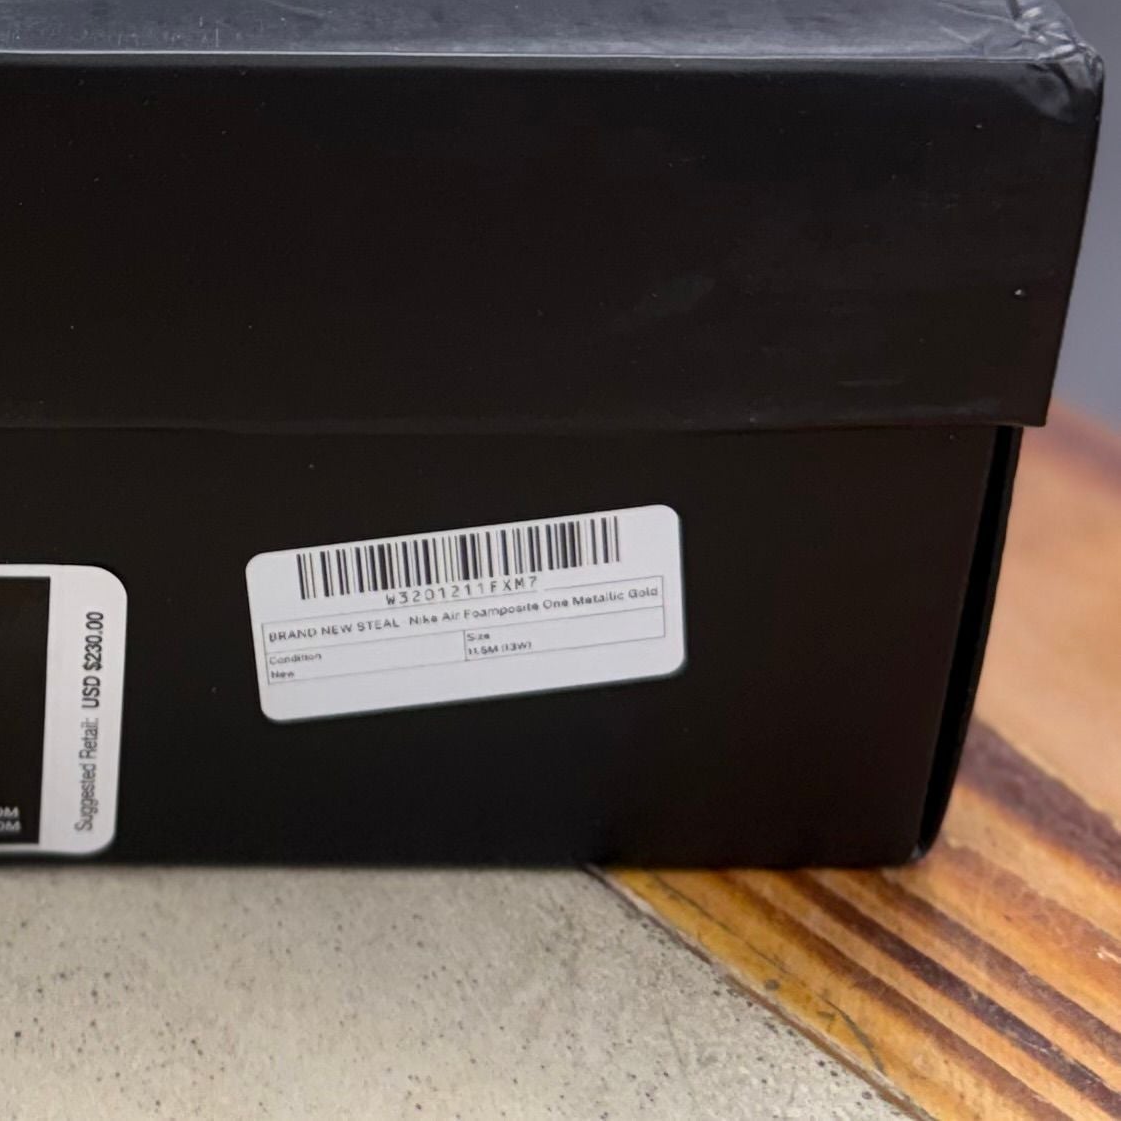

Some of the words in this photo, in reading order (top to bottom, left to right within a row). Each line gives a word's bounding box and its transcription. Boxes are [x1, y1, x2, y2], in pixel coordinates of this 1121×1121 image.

[385, 576, 538, 605] W3201211FXM7
[269, 629, 317, 643] BRAND
[321, 624, 353, 636] NEW
[357, 620, 400, 633] STEAL
[409, 614, 438, 626] Nike
[442, 611, 460, 622] Air
[464, 602, 539, 619] Foamposite
[542, 598, 569, 610] One
[572, 590, 625, 605] Metallic
[628, 586, 659, 599] Gold
[84, 611, 104, 672] $230.00
[269, 651, 322, 666] Condition
[81, 675, 102, 709] USD
[270, 670, 295, 679] New
[79, 718, 100, 760] Retail:
[75, 762, 99, 832] Suggested
